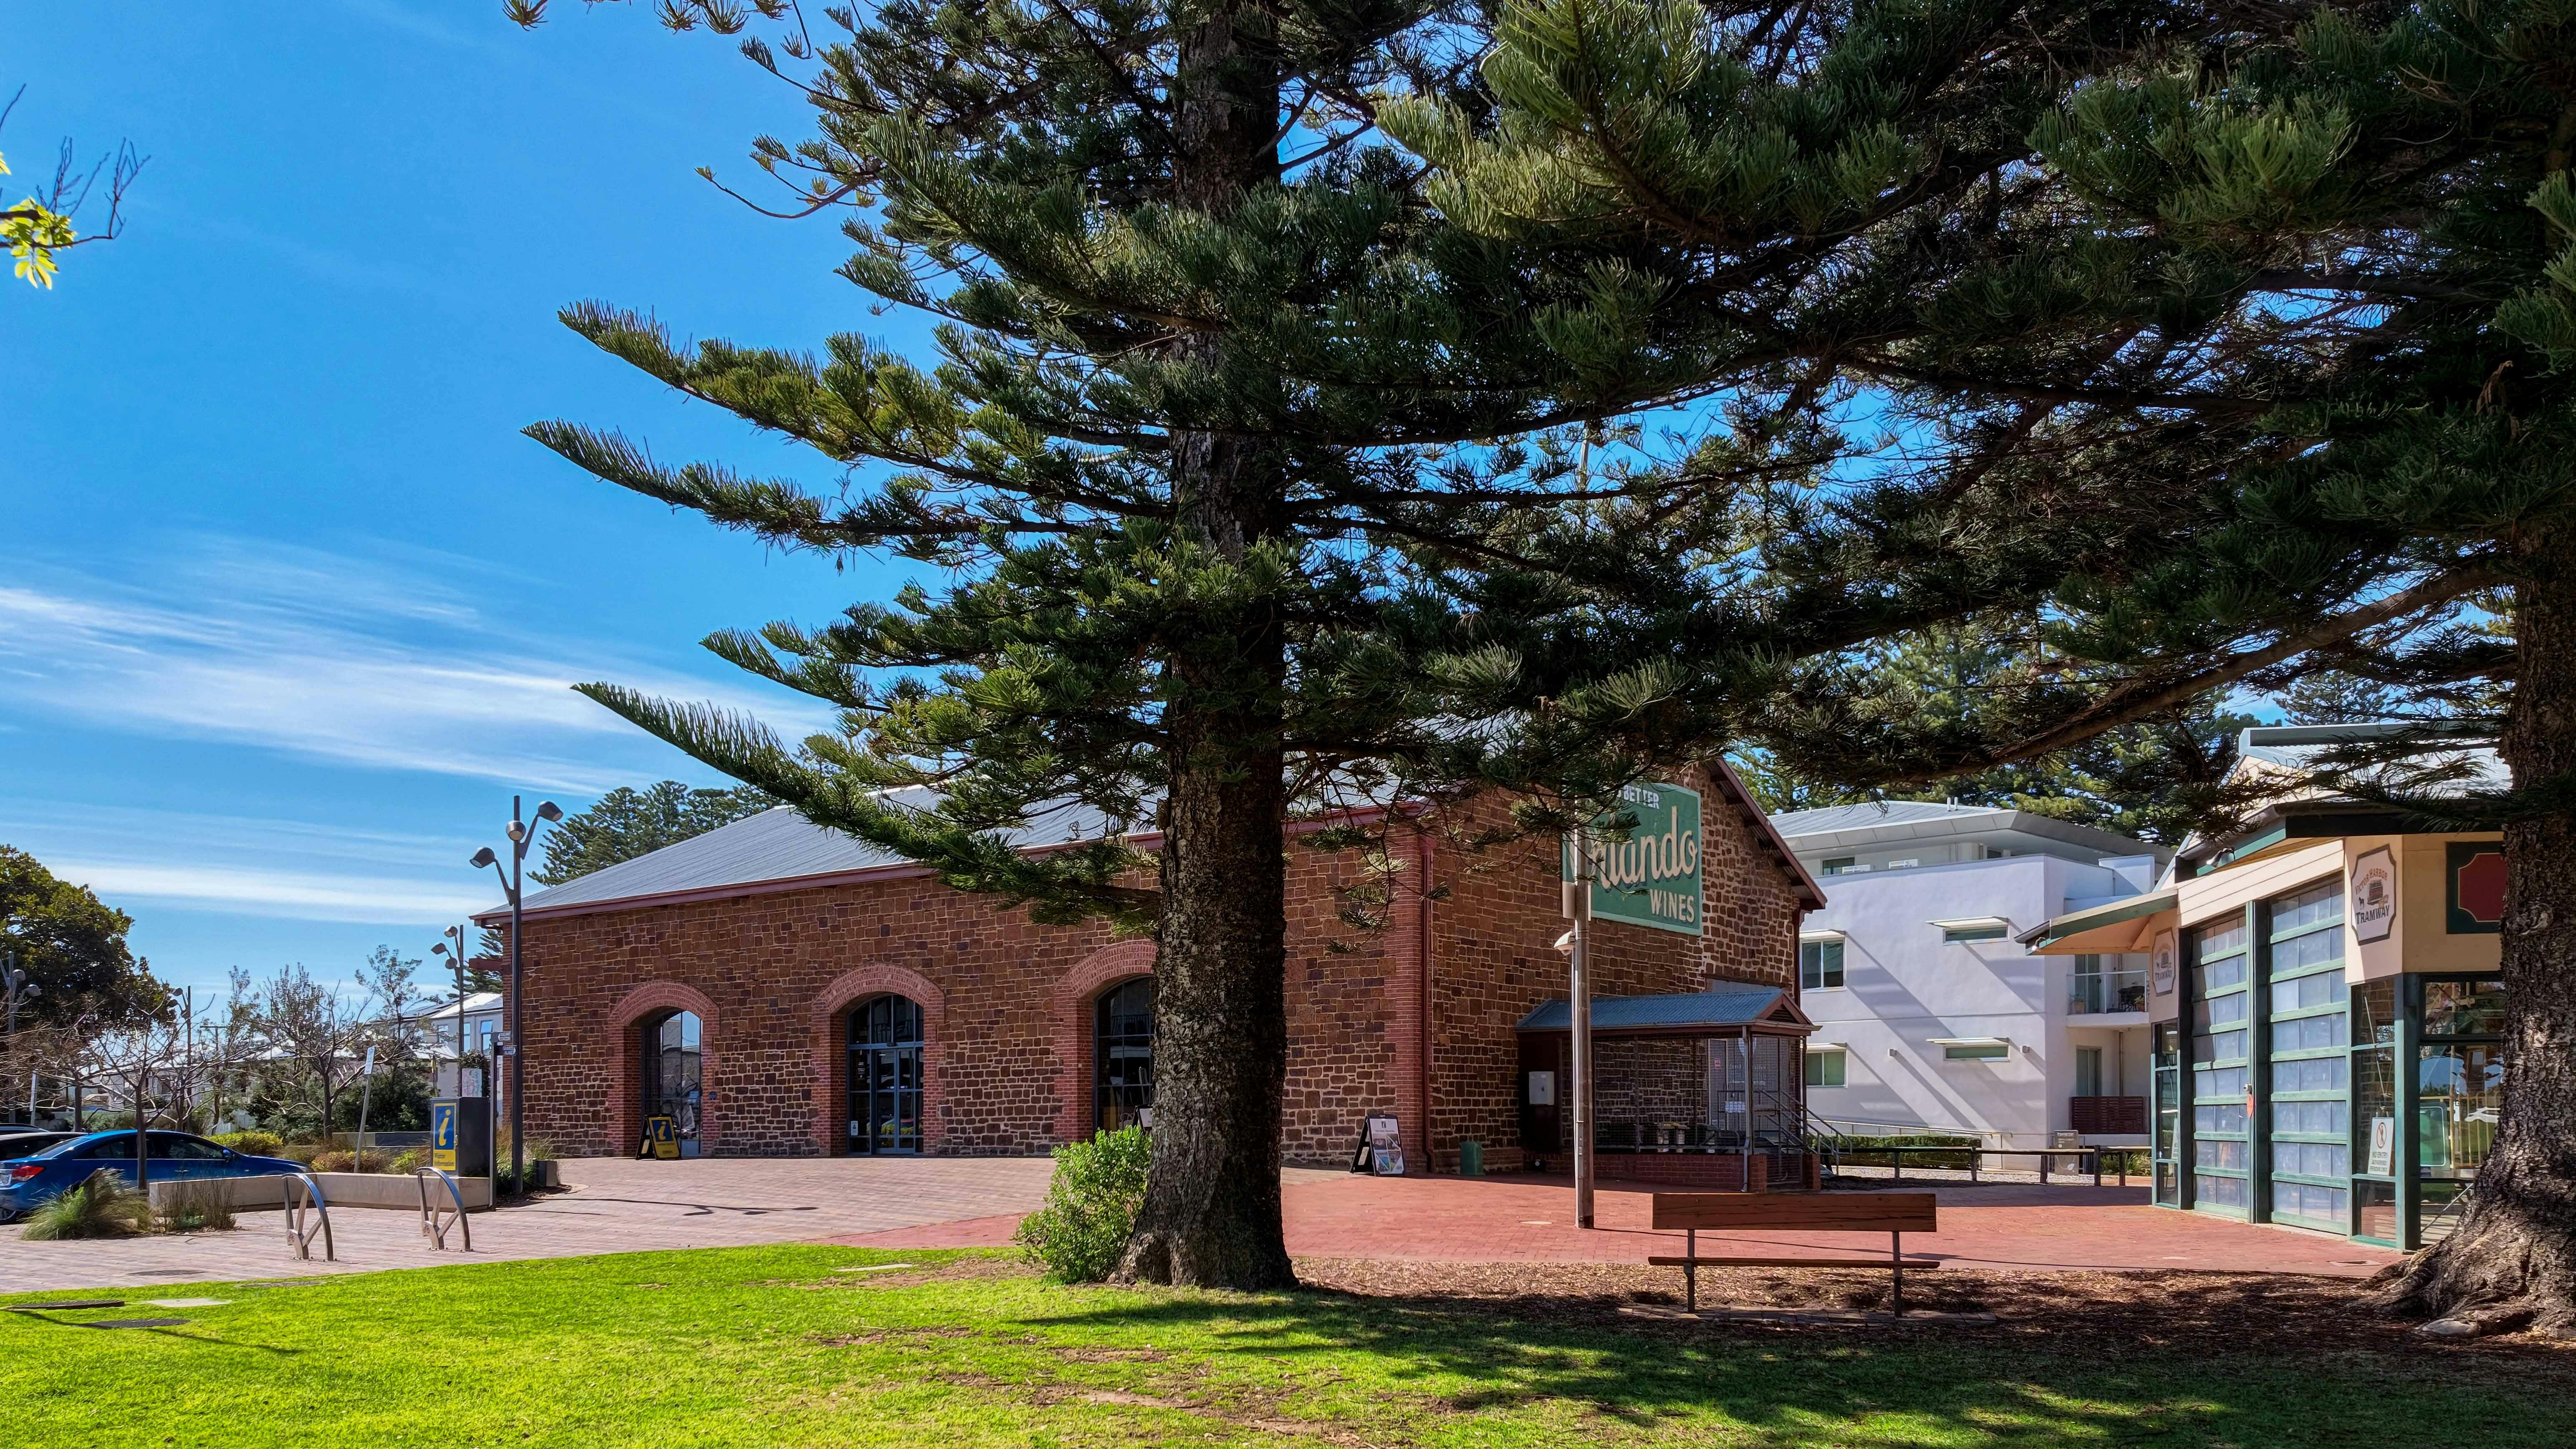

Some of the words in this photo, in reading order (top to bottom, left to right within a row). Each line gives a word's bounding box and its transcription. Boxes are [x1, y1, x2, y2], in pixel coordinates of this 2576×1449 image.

[1623, 785, 1659, 809] BETTER
[2369, 868, 2388, 881] HARBOR
[1649, 889, 1695, 923] WINES
[2356, 904, 2390, 925] TRAMWAY
